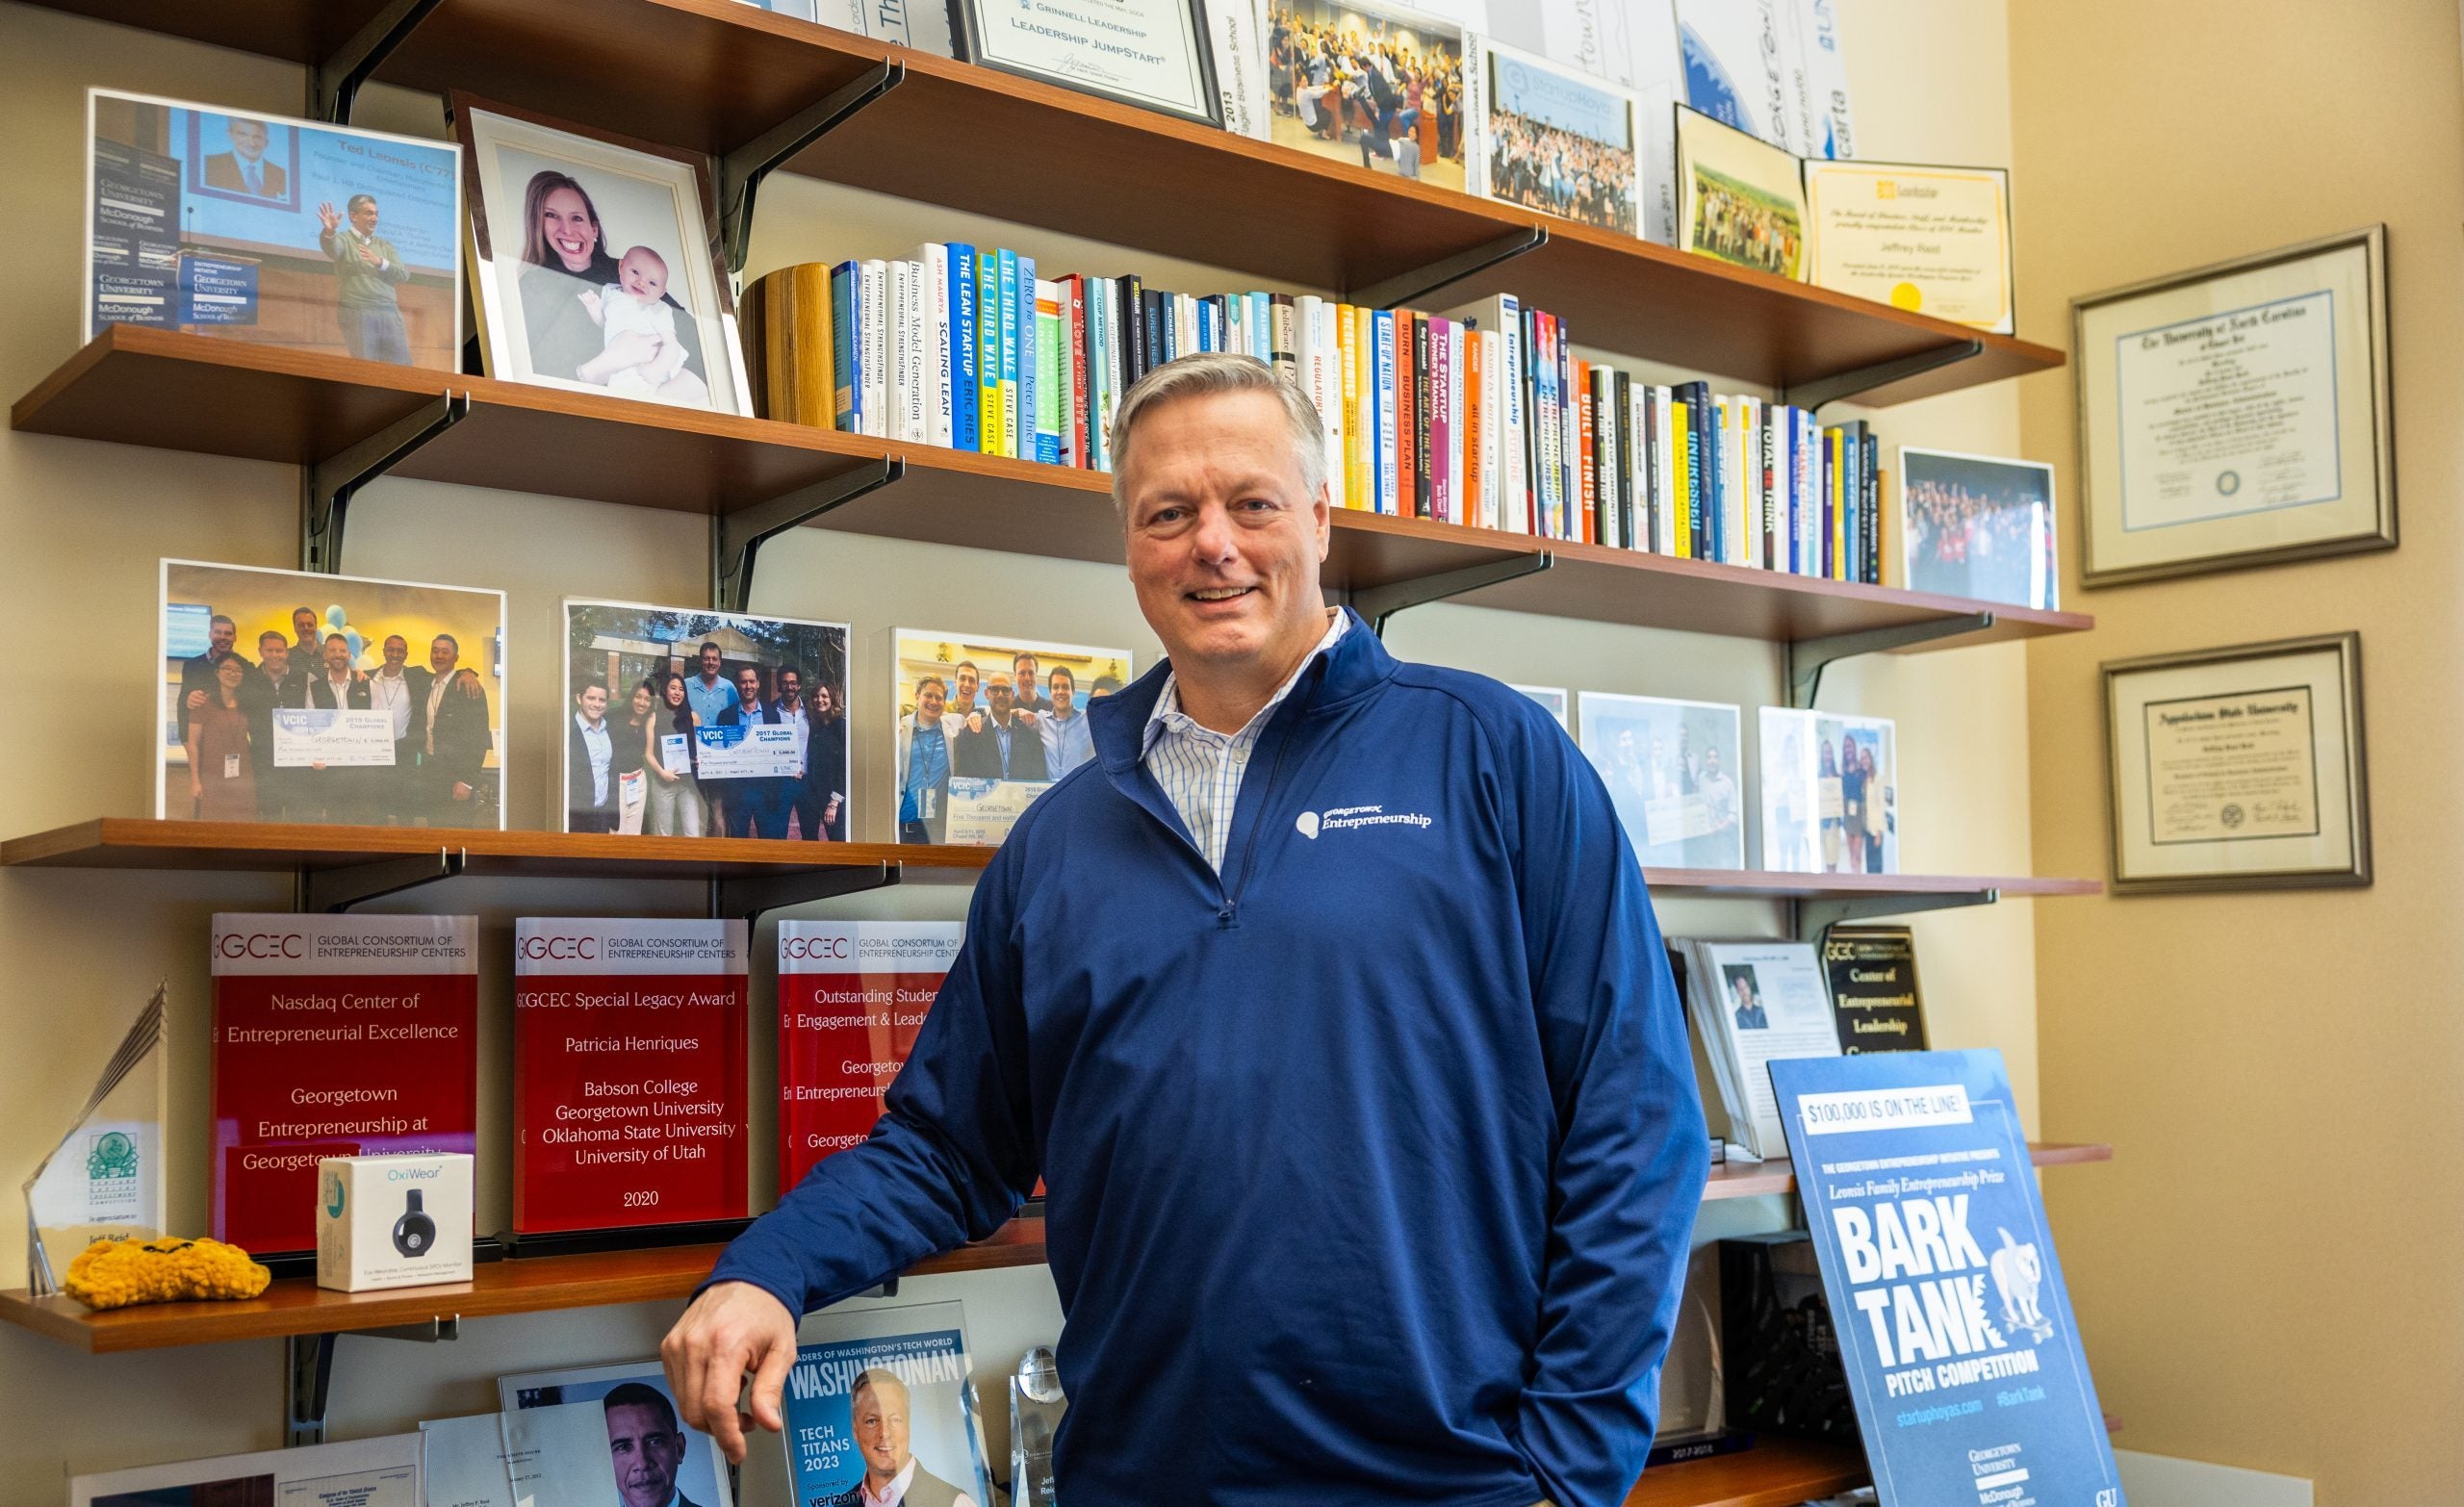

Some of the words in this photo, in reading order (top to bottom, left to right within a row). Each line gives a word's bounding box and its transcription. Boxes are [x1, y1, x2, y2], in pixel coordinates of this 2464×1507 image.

[1011, 17, 1088, 45] LEADERSHIP
[1037, 2, 1086, 23] GRINNELL
[1088, 15, 1147, 38] LEADERSHIP
[1229, 15, 1240, 51] School
[1235, 57, 1245, 101] Business
[1224, 91, 1236, 122] 2013
[1831, 89, 1853, 158] carta
[339, 140, 363, 155] Ted
[960, 254, 970, 278] THE
[983, 267, 994, 290] THE
[1002, 260, 1014, 283] THE
[100, 274, 165, 287] GEORGETOWN
[100, 284, 154, 295] UNIVERSITY
[911, 263, 920, 312] Business
[1023, 268, 1034, 305] ZERO
[98, 304, 153, 315] McDonough
[961, 280, 971, 316] LEAN
[1002, 291, 1014, 330] THIRD
[984, 295, 995, 336] THIRD
[1026, 310, 1033, 320] to
[911, 316, 922, 352] Model
[1024, 325, 1035, 357] ONE
[1073, 322, 1082, 356] LOVE
[1380, 322, 1392, 360] START-UP
[1439, 333, 1448, 359] THE
[939, 321, 949, 378] SCALING
[962, 319, 973, 377] STARTUP
[984, 342, 996, 379] WAVE
[1003, 337, 1015, 373] WAVE
[1076, 361, 1081, 370] AT
[1381, 362, 1392, 391] NATION
[911, 356, 922, 421] Generation
[1314, 356, 1323, 413] REGULATORY
[1507, 333, 1519, 424] Entrepreneurship
[941, 381, 950, 417] LEAN
[962, 380, 973, 408] ERIC
[1005, 388, 1014, 415] STEVE
[1025, 375, 1035, 408] Peter
[1431, 380, 1440, 421] MANUAL
[1439, 363, 1448, 423] STARTUP
[1026, 411, 1036, 445] Thiel
[1423, 418, 1430, 429] OF
[1473, 422, 1478, 433] in
[1581, 394, 1592, 438] BUILT
[965, 414, 974, 445] RIES
[1542, 385, 1552, 500] ENTREPRENEURSHIP
[1551, 385, 1560, 501] ENTREPRENEURSHIP
[1470, 437, 1479, 483] startup
[1583, 456, 1595, 510] FINISH
[282, 715, 307, 725] VCIC
[703, 730, 723, 740] VCIC
[953, 781, 971, 790] VCIC
[1322, 813, 1432, 830] Entrepreneurship
[220, 933, 302, 958] GCEC
[318, 935, 359, 946] GLOBAL
[363, 935, 434, 946] CONSORTIUM
[438, 935, 452, 946] OF
[318, 947, 419, 958] ENTREPRENEURSHIP
[421, 947, 466, 958] CENTERS
[526, 936, 595, 959] GCEC
[608, 938, 644, 948] GLOBAL
[647, 938, 708, 948] CONSORTIUM
[710, 938, 724, 948] OF
[608, 949, 695, 958] ENTREPRENEURSHIP
[697, 949, 735, 958] CENTERS
[1850, 968, 1884, 983] Center
[1884, 967, 1897, 982] of
[270, 994, 337, 1012] Nasdaq
[342, 994, 398, 1009] Center
[401, 993, 420, 1009] of
[526, 993, 571, 1008] GCEC
[575, 992, 629, 1009] Special
[634, 992, 683, 1009] Legacy
[688, 991, 735, 1006] Award
[815, 989, 893, 1006] Outstanding
[1837, 992, 1914, 1011] Entrepreneurial
[797, 1014, 877, 1030] Engagement
[880, 1012, 890, 1025] &
[1853, 1018, 1908, 1035] Leadership
[227, 1025, 362, 1045] Entrepreneurial
[369, 1024, 458, 1039] Excellence
[566, 1036, 621, 1053] Patricia
[625, 1035, 699, 1053] Henriques
[291, 1087, 398, 1107] Georgetown
[584, 1082, 639, 1097] Babson
[643, 1080, 698, 1097] College
[555, 1105, 649, 1121] Georgetown
[653, 1100, 724, 1117] University
[1809, 1101, 1867, 1124] $100,000
[1868, 1101, 1882, 1118] IS
[1885, 1099, 1904, 1117] ON
[1906, 1097, 1927, 1115] THE
[1930, 1094, 1961, 1113] LINE!
[258, 1116, 408, 1138] Entrepreneurship
[412, 1116, 428, 1131] at
[542, 1127, 620, 1143] Oklahoma
[624, 1125, 661, 1140] State
[665, 1122, 735, 1139] University
[576, 1148, 650, 1165] University
[653, 1146, 669, 1161] of
[672, 1144, 706, 1160] Utah
[1830, 1183, 1865, 1200] Leonsis
[1866, 1179, 1900, 1198] Family
[1901, 1171, 1979, 1195] Entrepreneurship
[1979, 1169, 2005, 1185] Prize
[624, 1191, 658, 1207] 2020
[1833, 1194, 1988, 1284] BARK
[1854, 1273, 2008, 1367] TANK
[797, 1352, 822, 1363] ADERS
[836, 1342, 902, 1358] WASHINGTON'S
[903, 1340, 922, 1350] TECH
[923, 1338, 953, 1347] WORLD
[1886, 1367, 1936, 1398] PITCH
[1938, 1349, 2040, 1389] COMPETITION
[1896, 1399, 1983, 1427] startuphoyas.com
[1996, 1386, 2045, 1408] #BarkTank
[799, 1424, 834, 1441] TECH
[802, 1438, 850, 1456] TITANS
[805, 1455, 839, 1472] 2023
[807, 1479, 839, 1492] Sponsored
[840, 1478, 849, 1488] by
[808, 1490, 859, 1507] verizon
